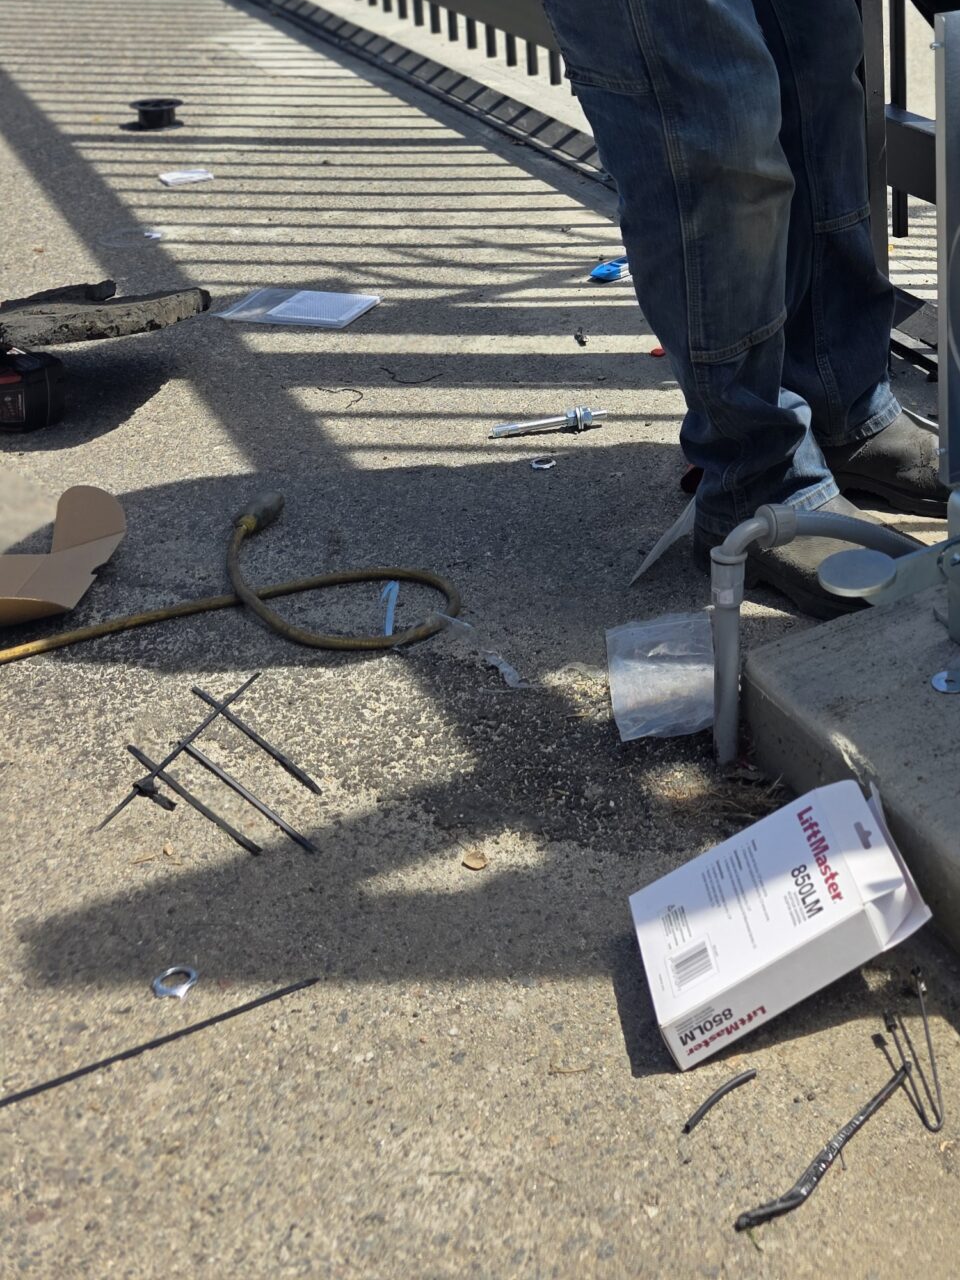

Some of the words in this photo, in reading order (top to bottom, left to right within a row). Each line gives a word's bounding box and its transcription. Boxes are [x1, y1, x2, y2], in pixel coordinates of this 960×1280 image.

[797, 806, 843, 902] LiftMaster
[791, 864, 824, 919] 850LM
[680, 1008, 733, 1047] 850LM
[686, 1005, 767, 1057] LiftMaster
